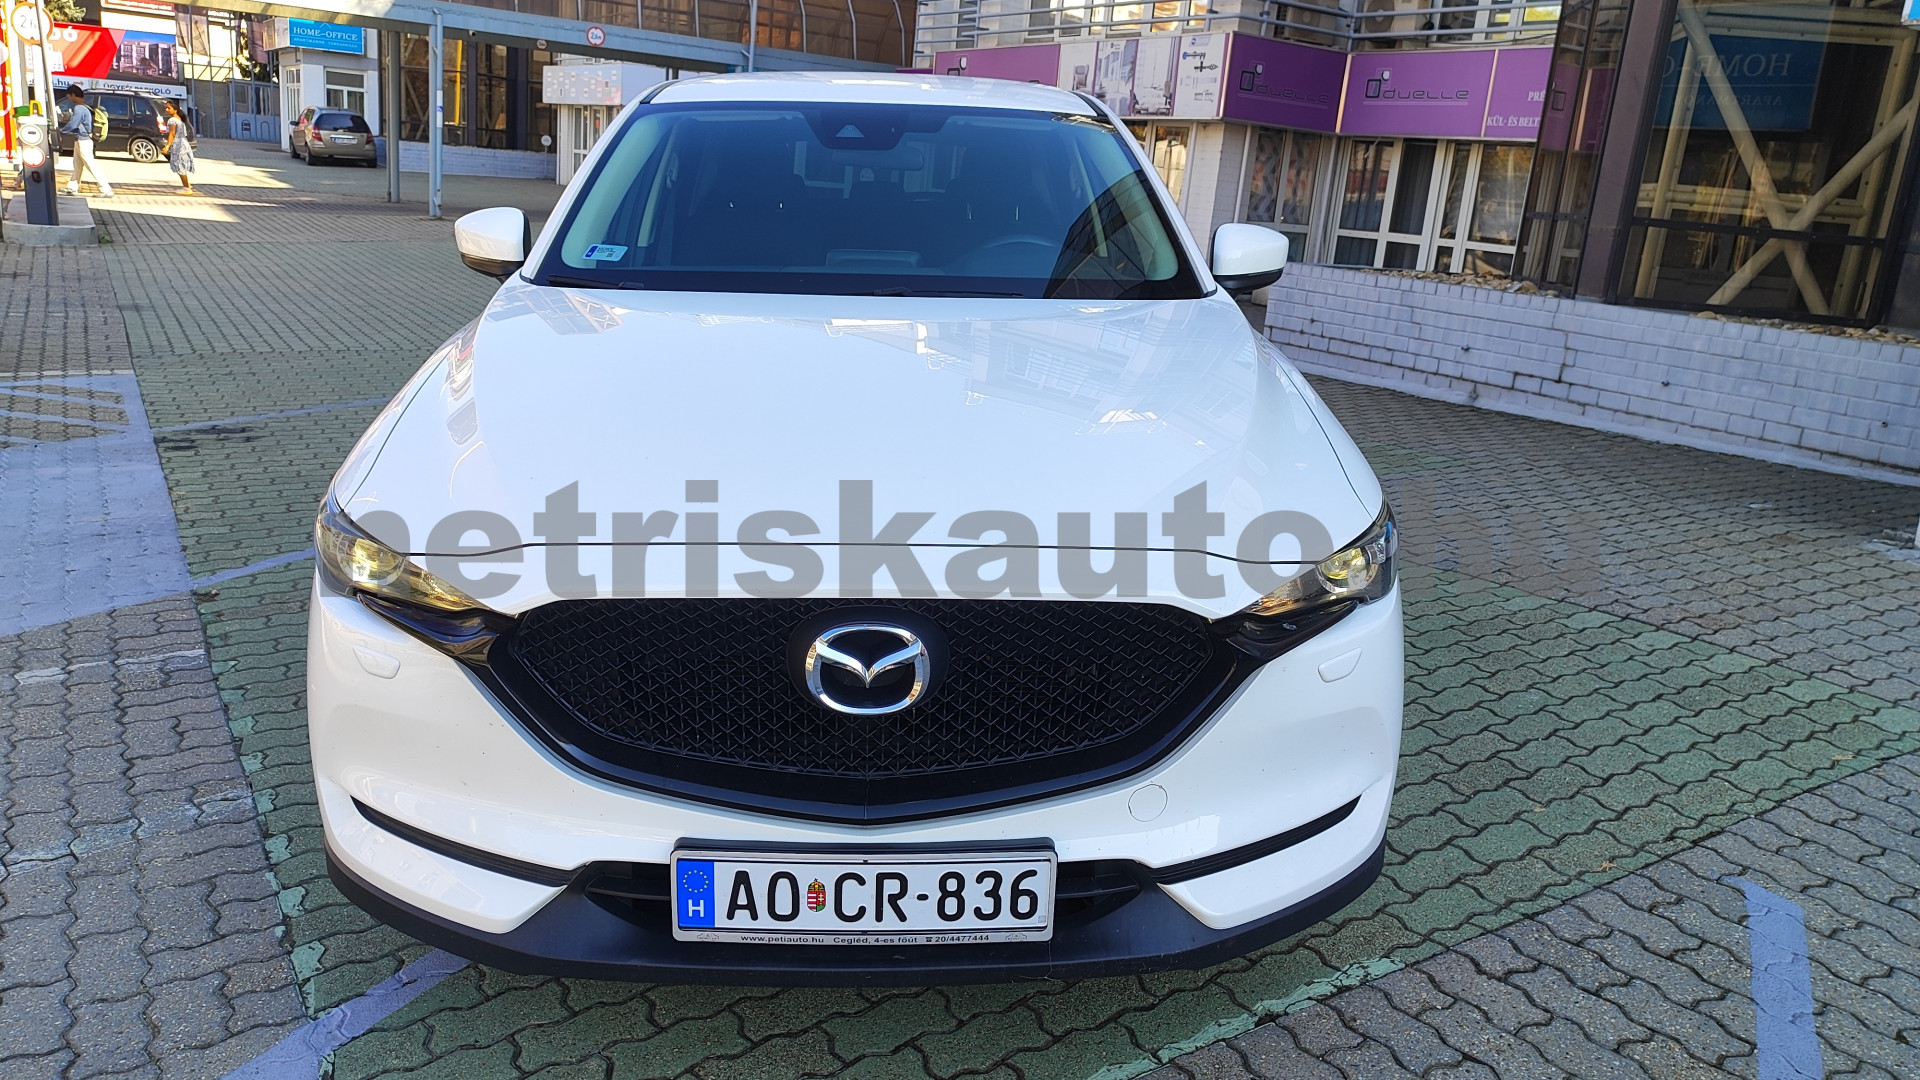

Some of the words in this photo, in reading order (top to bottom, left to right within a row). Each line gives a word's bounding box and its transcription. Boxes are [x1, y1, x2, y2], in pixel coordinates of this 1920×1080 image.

[293, 26, 358, 41] HOME-OFFICE
[1507, 115, 1518, 127] ÉS
[726, 869, 800, 923] AO
[833, 869, 1039, 923] CR-836
[687, 898, 705, 918] H
[740, 934, 824, 944] www.petiauto.hu
[833, 936, 871, 944] Cegléd,
[873, 936, 896, 944] 4-es
[934, 934, 990, 943] 20/4477444
